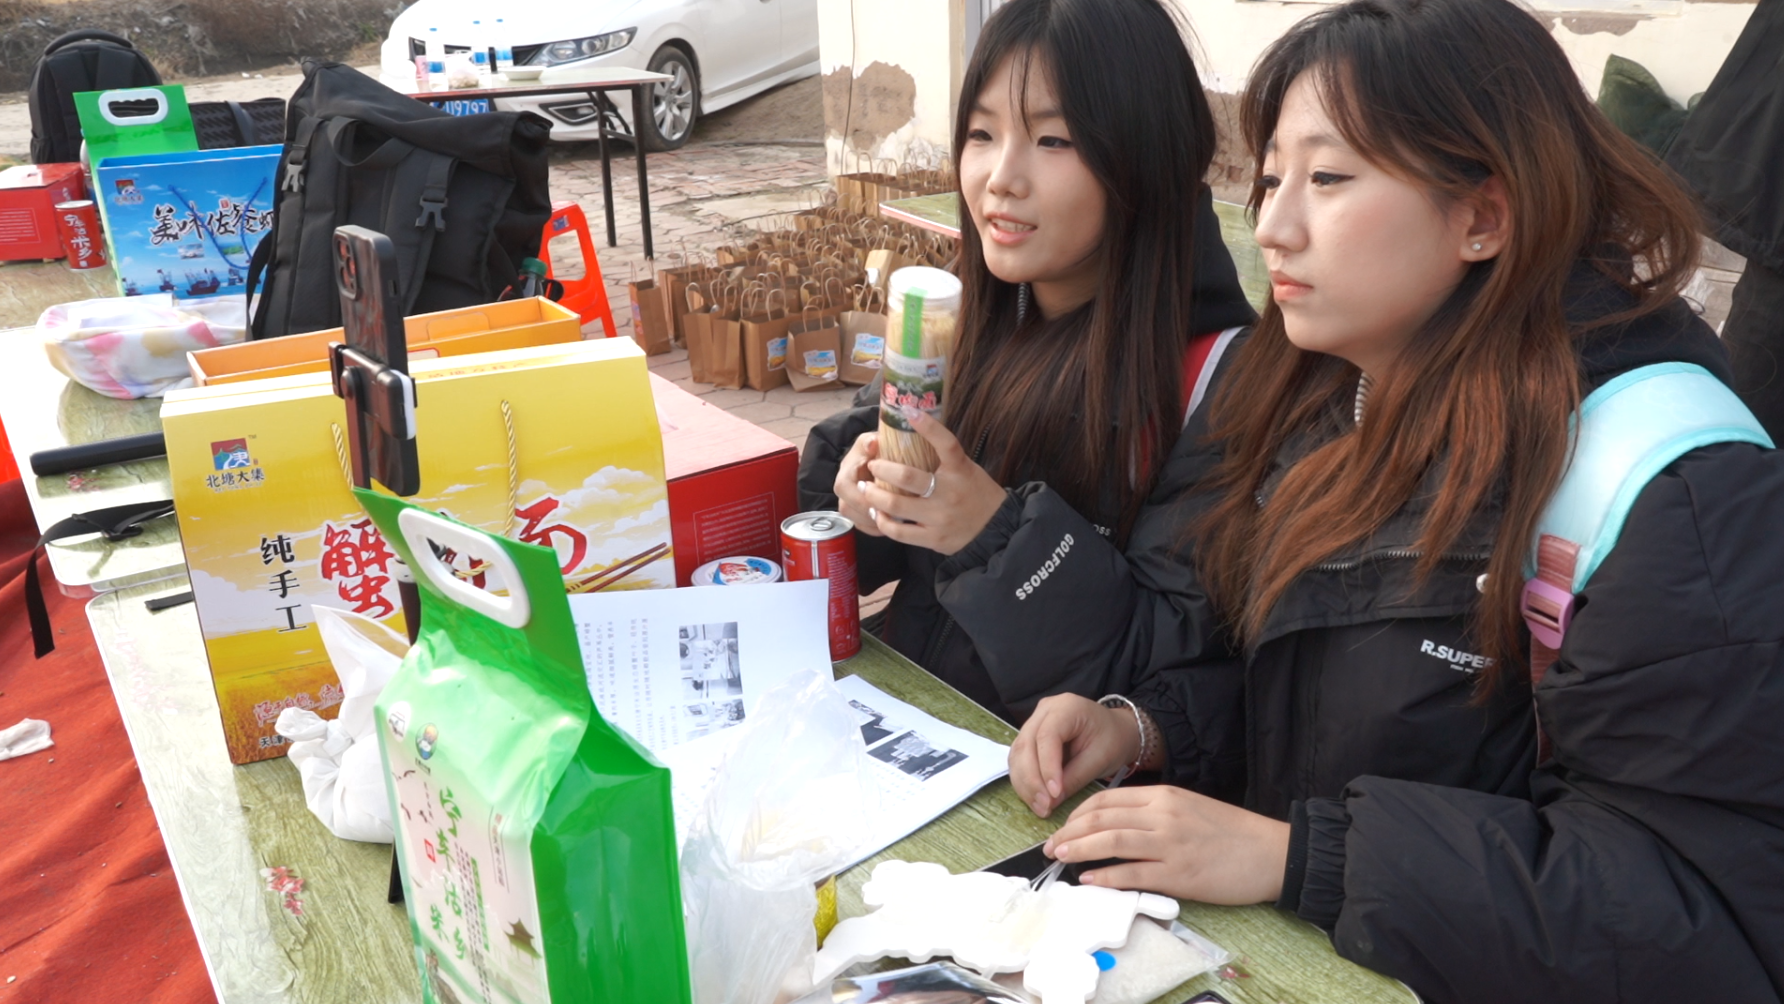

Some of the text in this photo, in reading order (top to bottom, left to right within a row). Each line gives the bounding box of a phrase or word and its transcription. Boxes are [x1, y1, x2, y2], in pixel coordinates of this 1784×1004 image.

[206, 467, 264, 488] 北塘大集
[261, 535, 307, 632] 纯手工
[1015, 533, 1075, 600] GOLFCROSS
